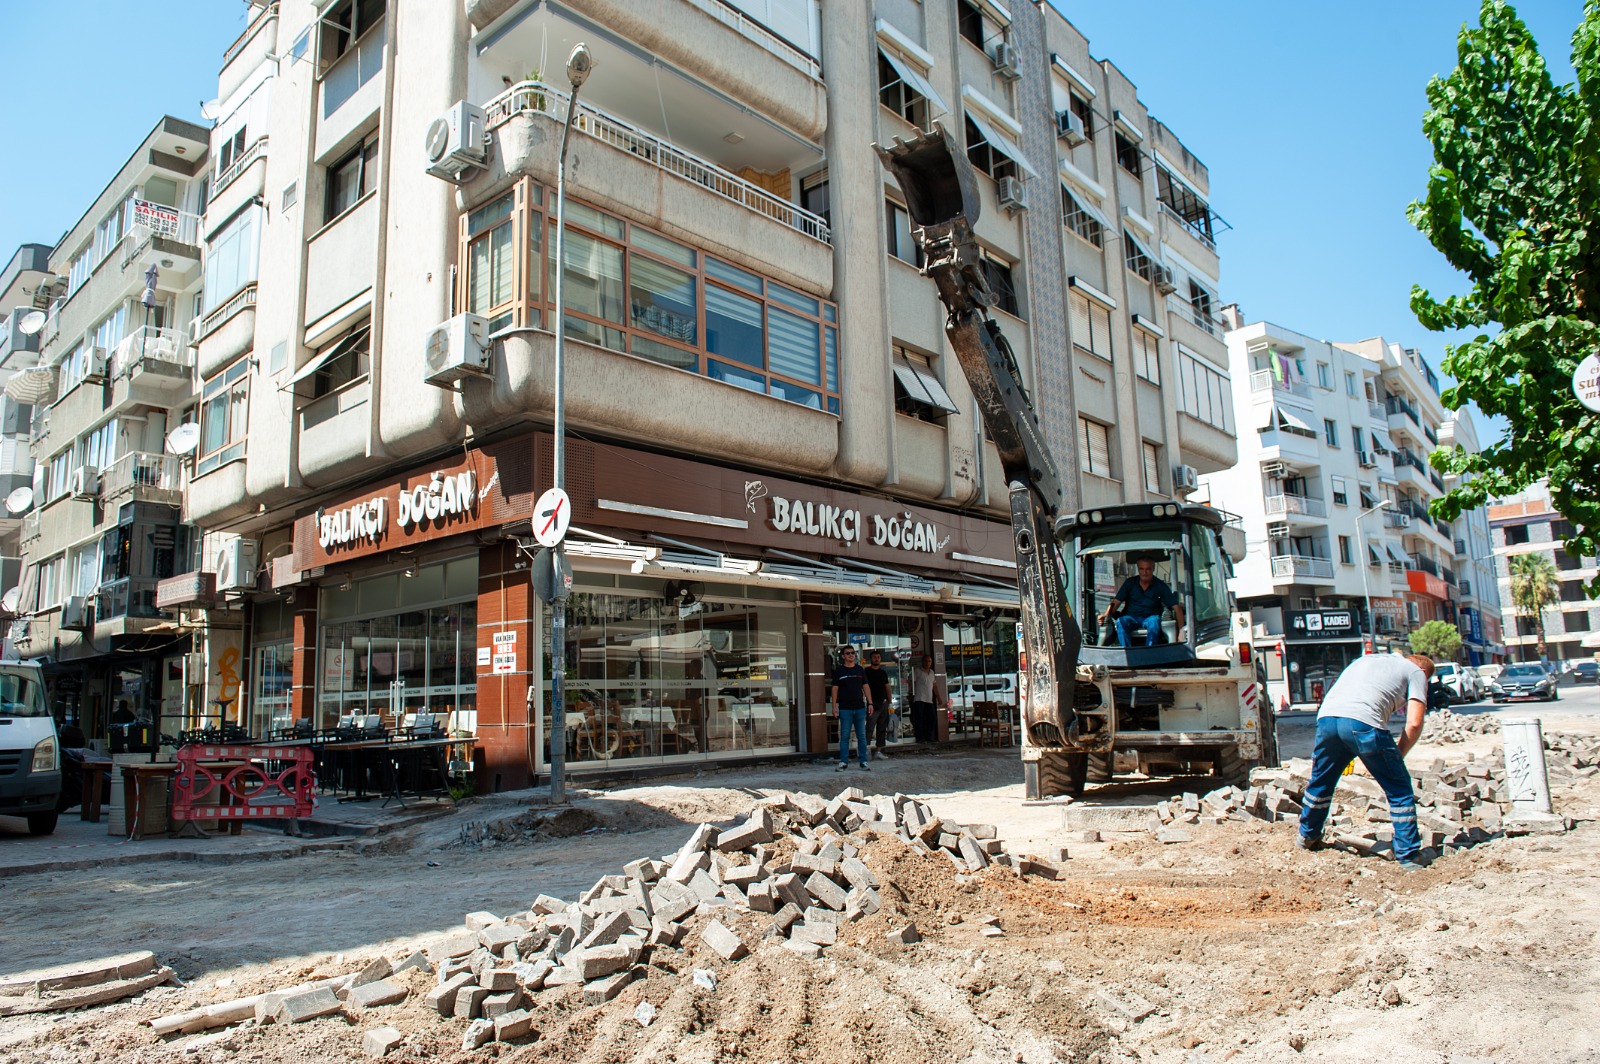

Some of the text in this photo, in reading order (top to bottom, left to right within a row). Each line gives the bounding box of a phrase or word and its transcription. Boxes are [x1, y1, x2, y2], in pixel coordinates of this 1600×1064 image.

[135, 206, 178, 222] SATILIK
[319, 497, 388, 548] BALIKÇI
[397, 470, 476, 527] DOĞAN
[771, 496, 937, 553] BALIKÇI DOĞAN
[1049, 559, 1065, 646] KARŞIYAKA BELEDİYESİ
[1323, 615, 1349, 626] KADEH
